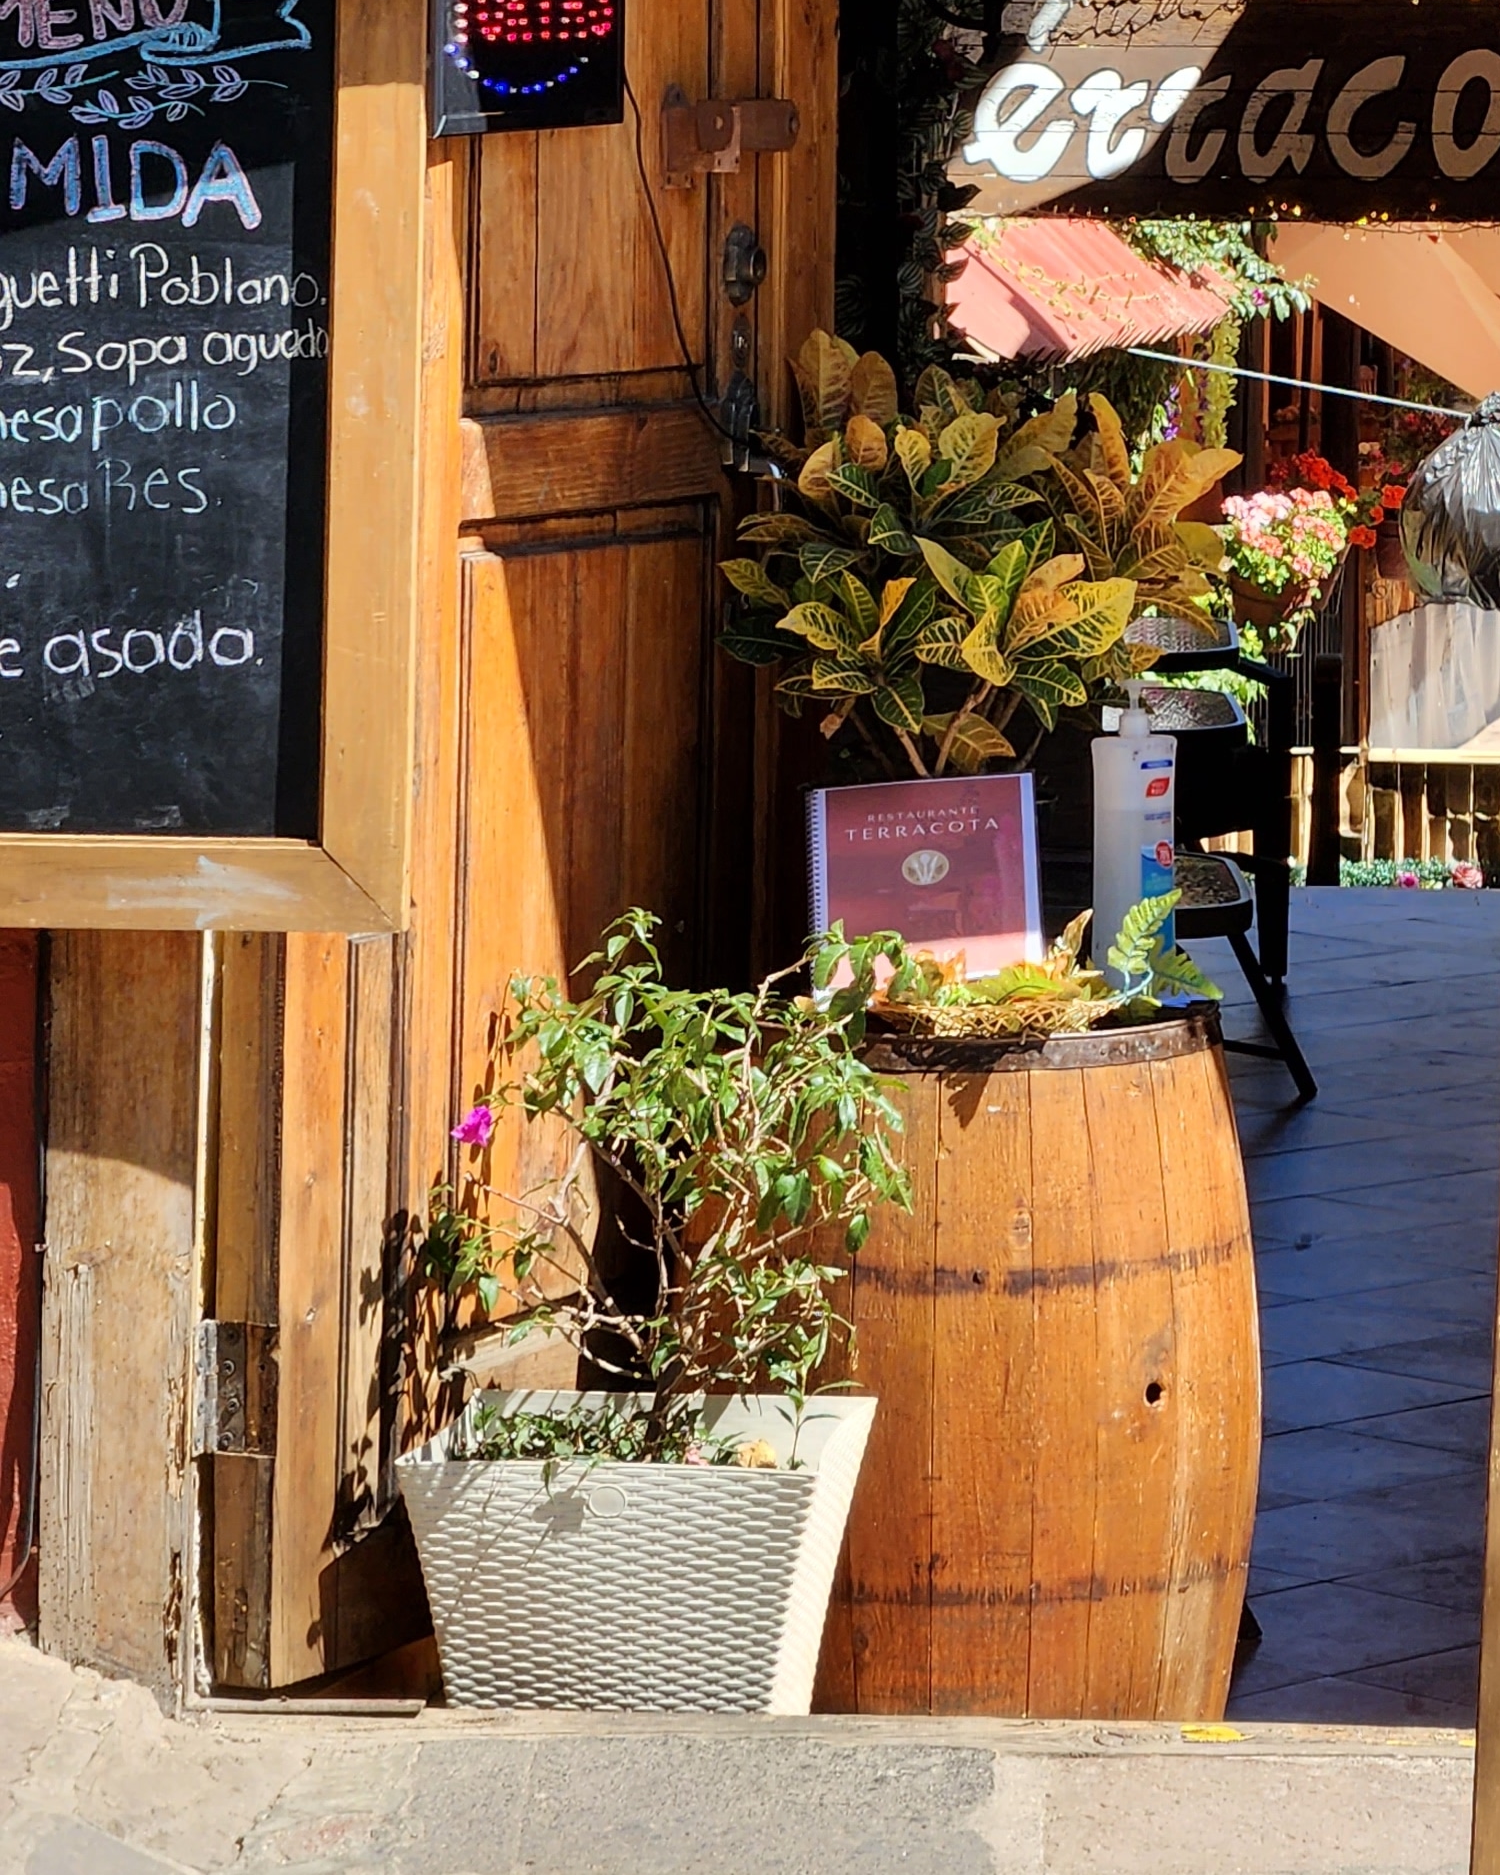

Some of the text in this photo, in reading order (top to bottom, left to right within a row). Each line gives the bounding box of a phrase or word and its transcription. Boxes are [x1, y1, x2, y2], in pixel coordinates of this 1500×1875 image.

[9, 135, 262, 230] MIDA
[57, 331, 188, 387] Sopa
[844, 817, 999, 842] TERRACOTA
[867, 806, 979, 823] RESTAURANTE
